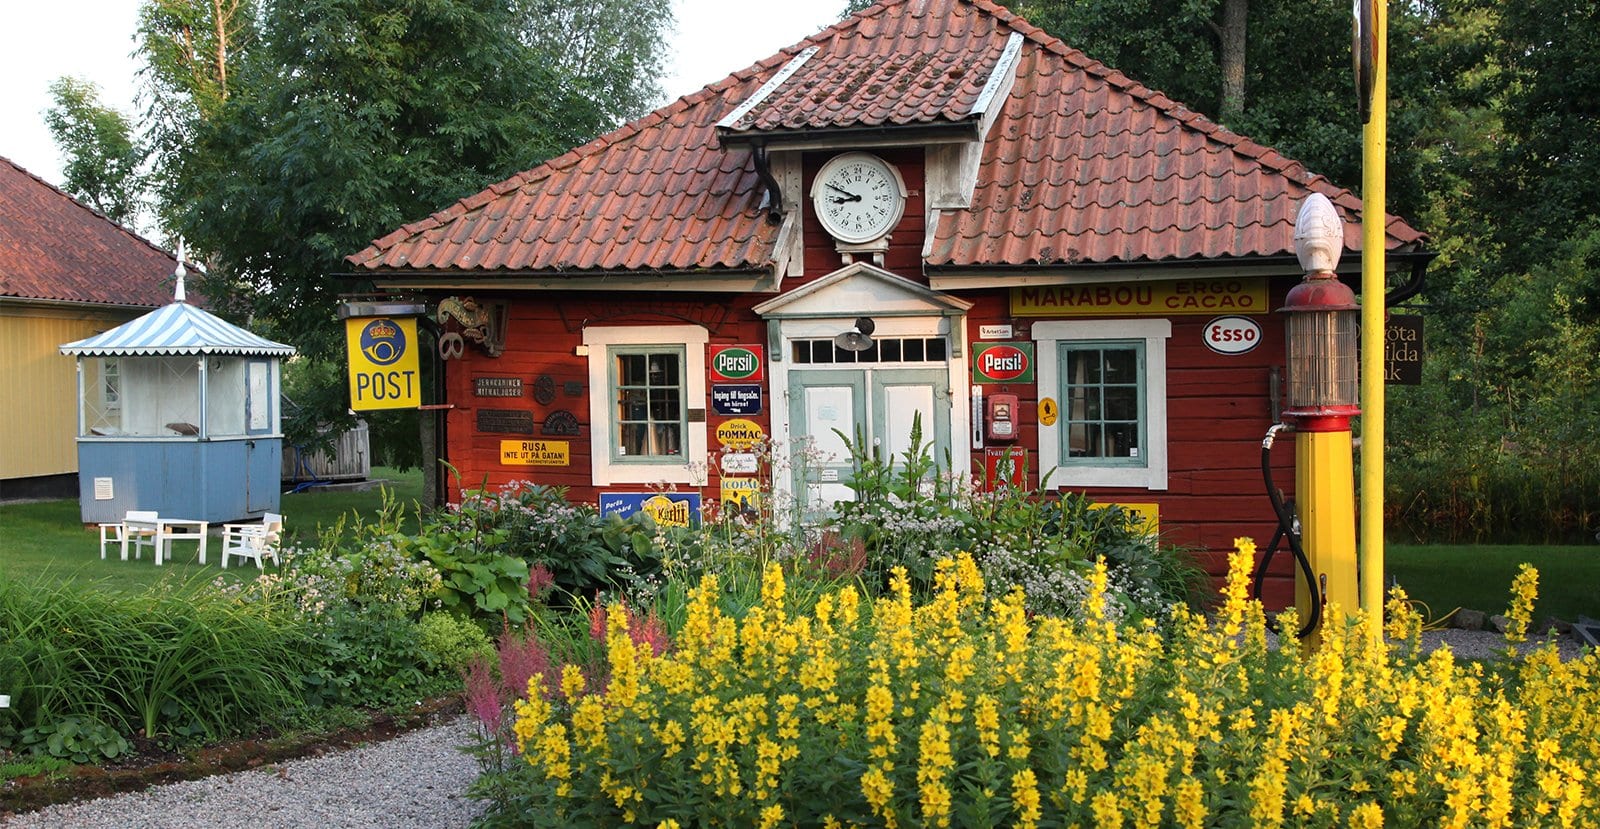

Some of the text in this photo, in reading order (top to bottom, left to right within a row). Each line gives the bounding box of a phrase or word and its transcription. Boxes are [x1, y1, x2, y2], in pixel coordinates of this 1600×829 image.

[1175, 280, 1242, 295] ERGO
[1020, 286, 1152, 307] MARABOU
[1165, 295, 1254, 308] CACAO
[719, 354, 752, 372] Persil
[985, 353, 1022, 372] Persil
[356, 371, 415, 400] POST
[718, 430, 761, 440] POMMAC
[522, 442, 547, 452] RUSA
[1010, 449, 1024, 457] med
[532, 451, 540, 459] PÅ
